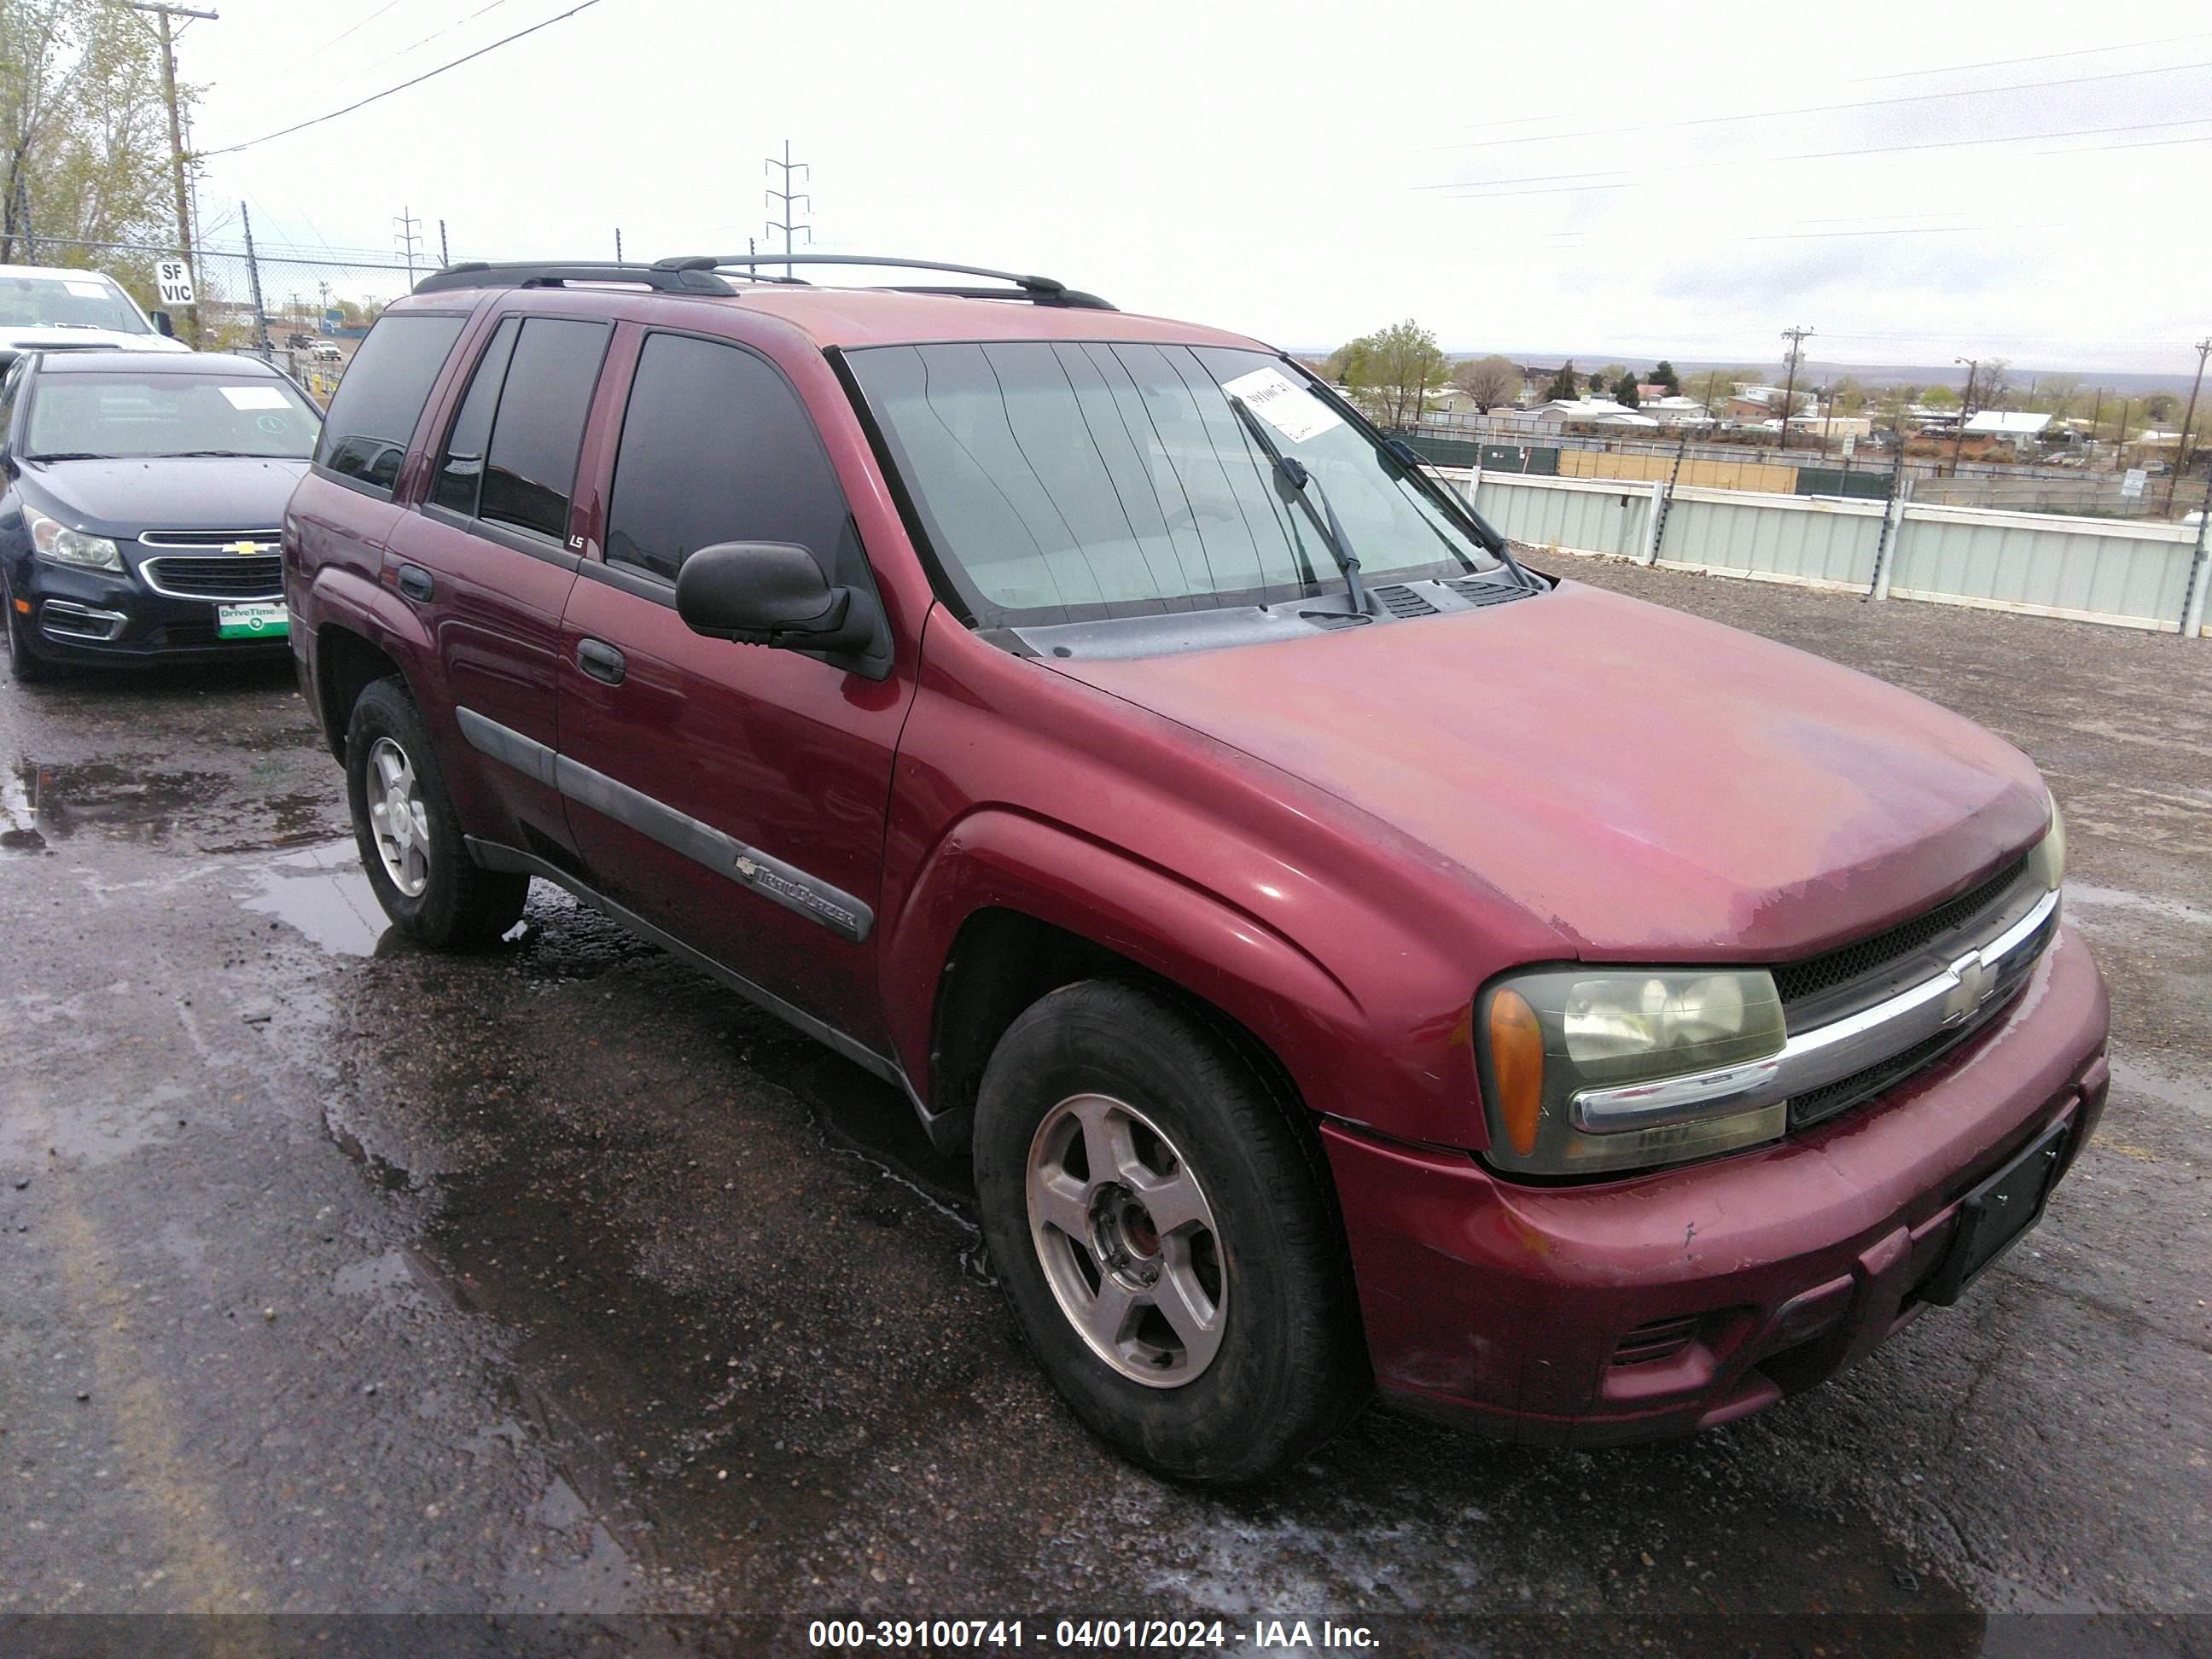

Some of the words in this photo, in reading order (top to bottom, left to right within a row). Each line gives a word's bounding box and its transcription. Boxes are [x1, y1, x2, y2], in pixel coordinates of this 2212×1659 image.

[162, 265, 182, 280] SF
[161, 285, 191, 300] VIC
[569, 534, 585, 549] LS
[221, 608, 275, 617] DriveTime
